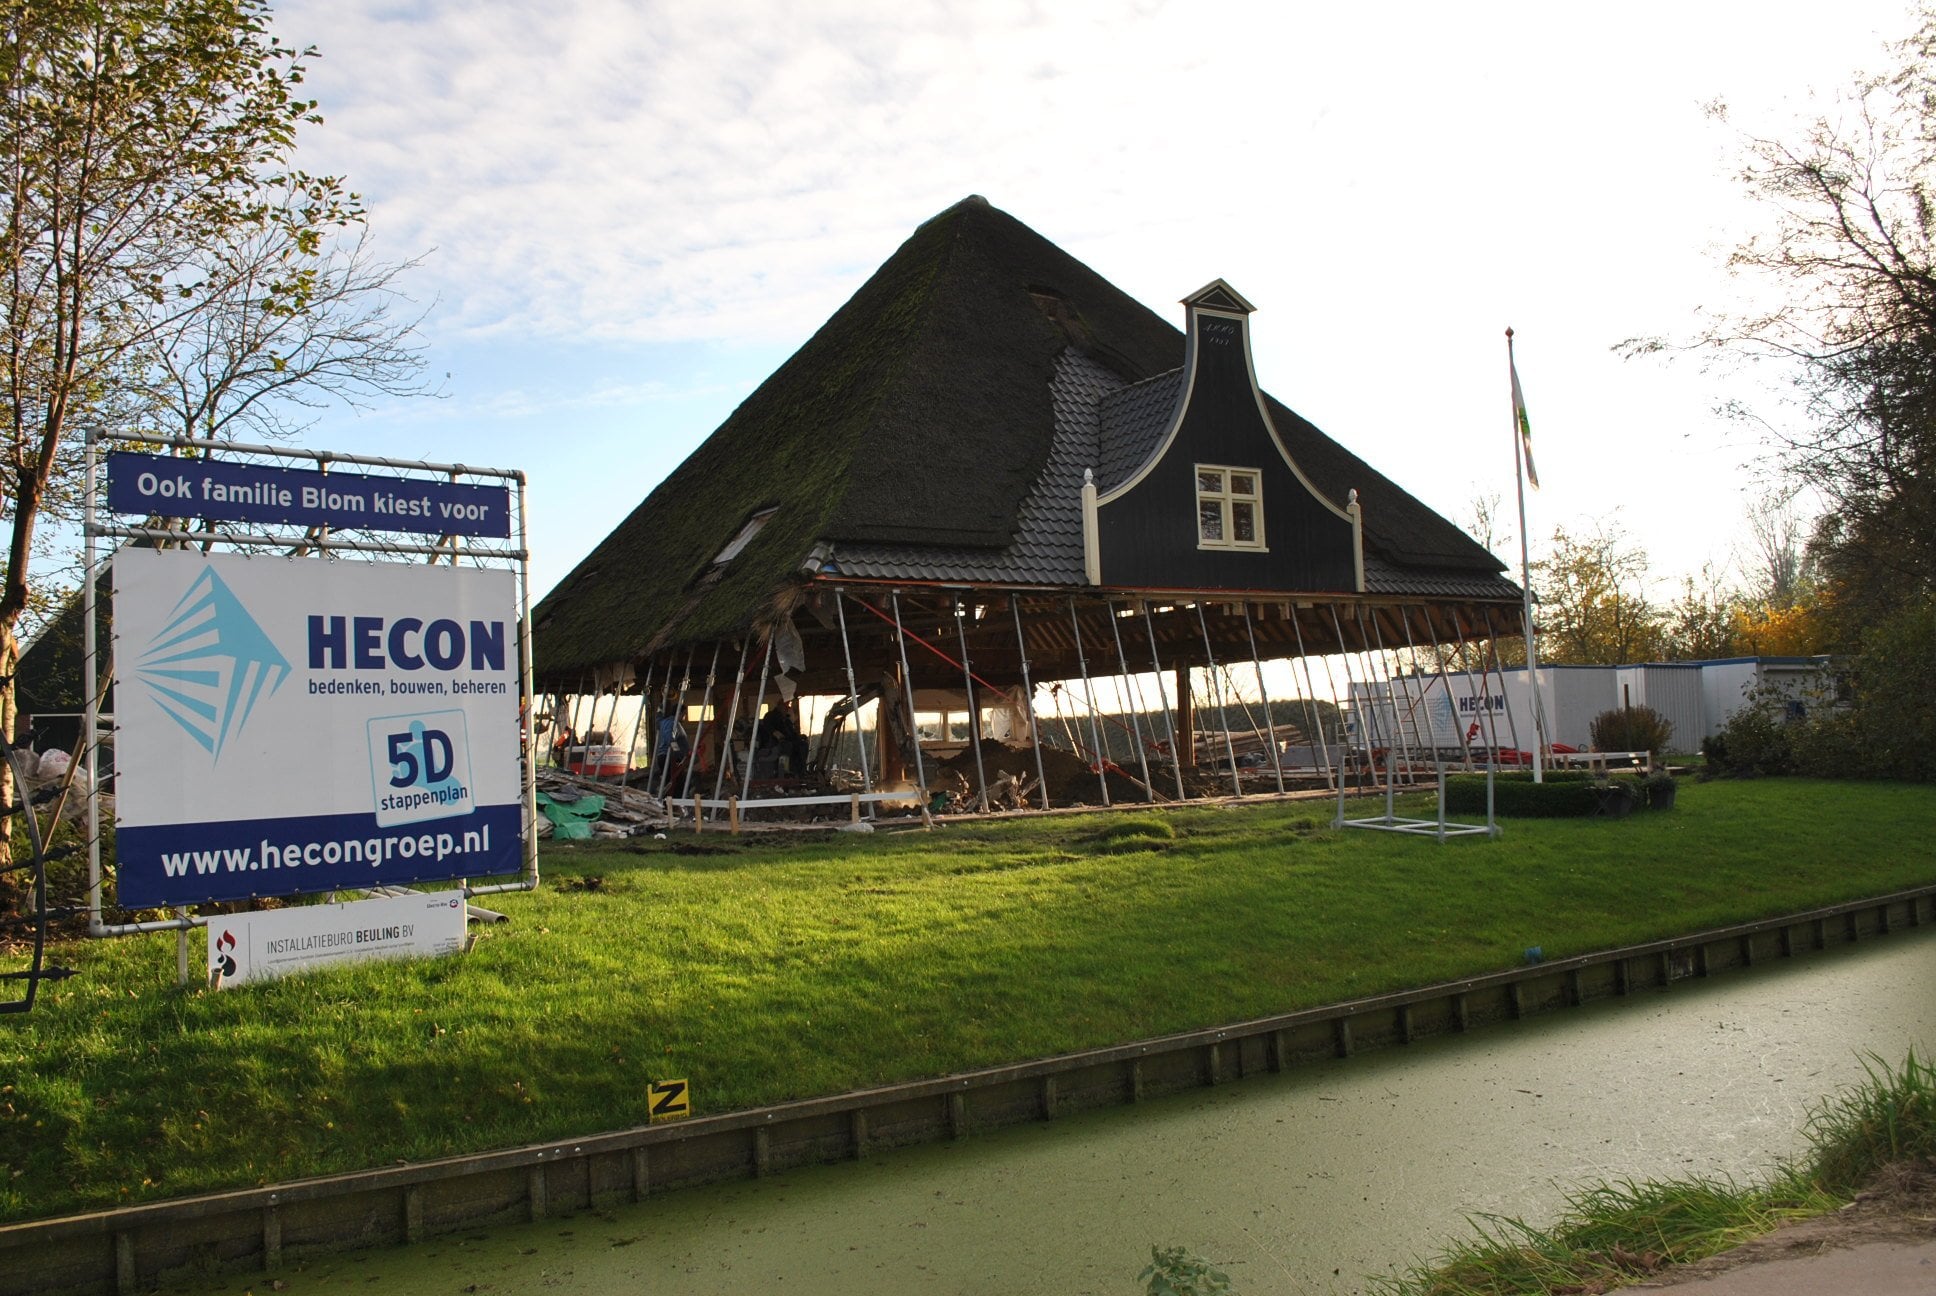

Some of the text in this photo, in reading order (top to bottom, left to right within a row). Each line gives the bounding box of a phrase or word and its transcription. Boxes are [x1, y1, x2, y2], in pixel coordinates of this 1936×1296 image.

[137, 472, 488, 521] Ook familie Blom kiest voor
[308, 614, 505, 671] HECON
[308, 678, 506, 697] bedenken, bouwen, beheren
[387, 729, 454, 789] 5D
[381, 784, 468, 811] stappenplan
[161, 824, 489, 877] www.hecongroep.nl
[267, 931, 353, 954] INSTALLATIEBURO
[356, 926, 400, 943] BEULING
[402, 924, 414, 938] BV
[652, 1082, 687, 1116] Z
